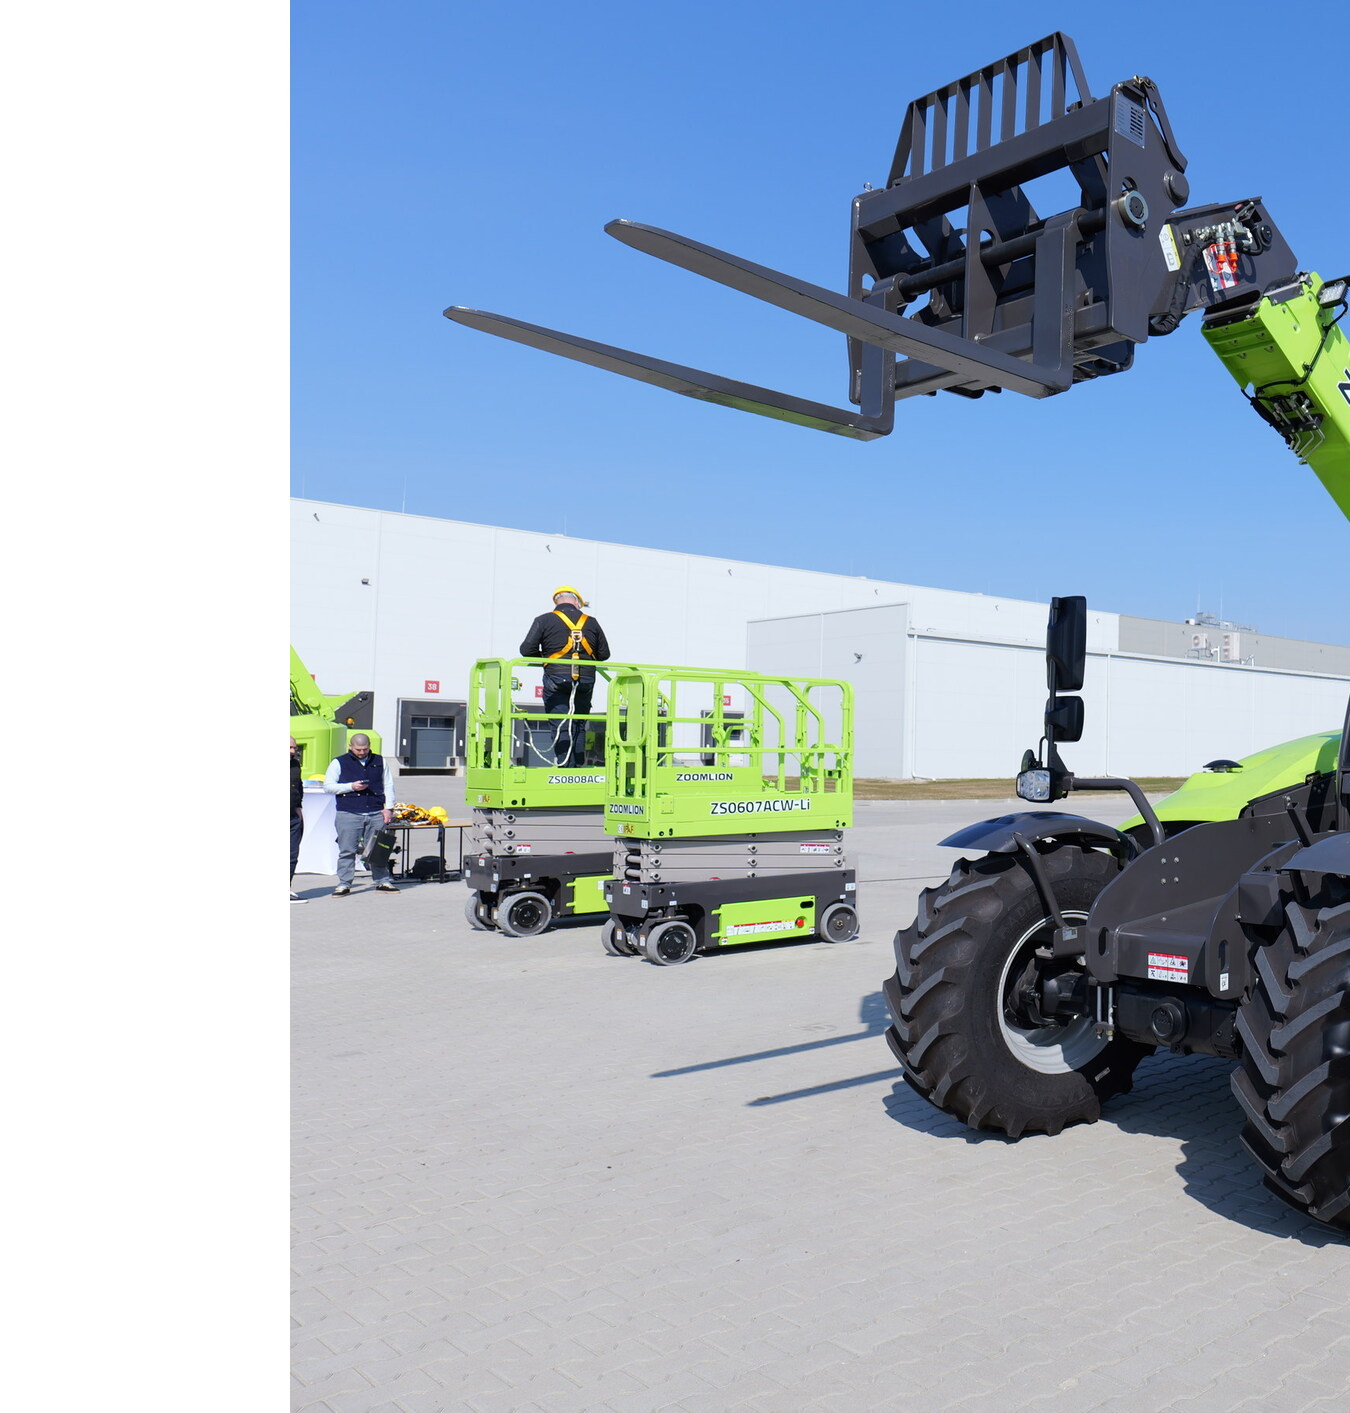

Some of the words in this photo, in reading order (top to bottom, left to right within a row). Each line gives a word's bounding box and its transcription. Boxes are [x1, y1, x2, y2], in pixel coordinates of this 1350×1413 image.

[427, 683, 437, 691] 38
[548, 775, 605, 784] ZS0808AC-
[676, 773, 733, 781] ZOOMLION
[609, 804, 644, 815] ZOOMLION
[710, 799, 810, 815] ZS0607ACW-Li
